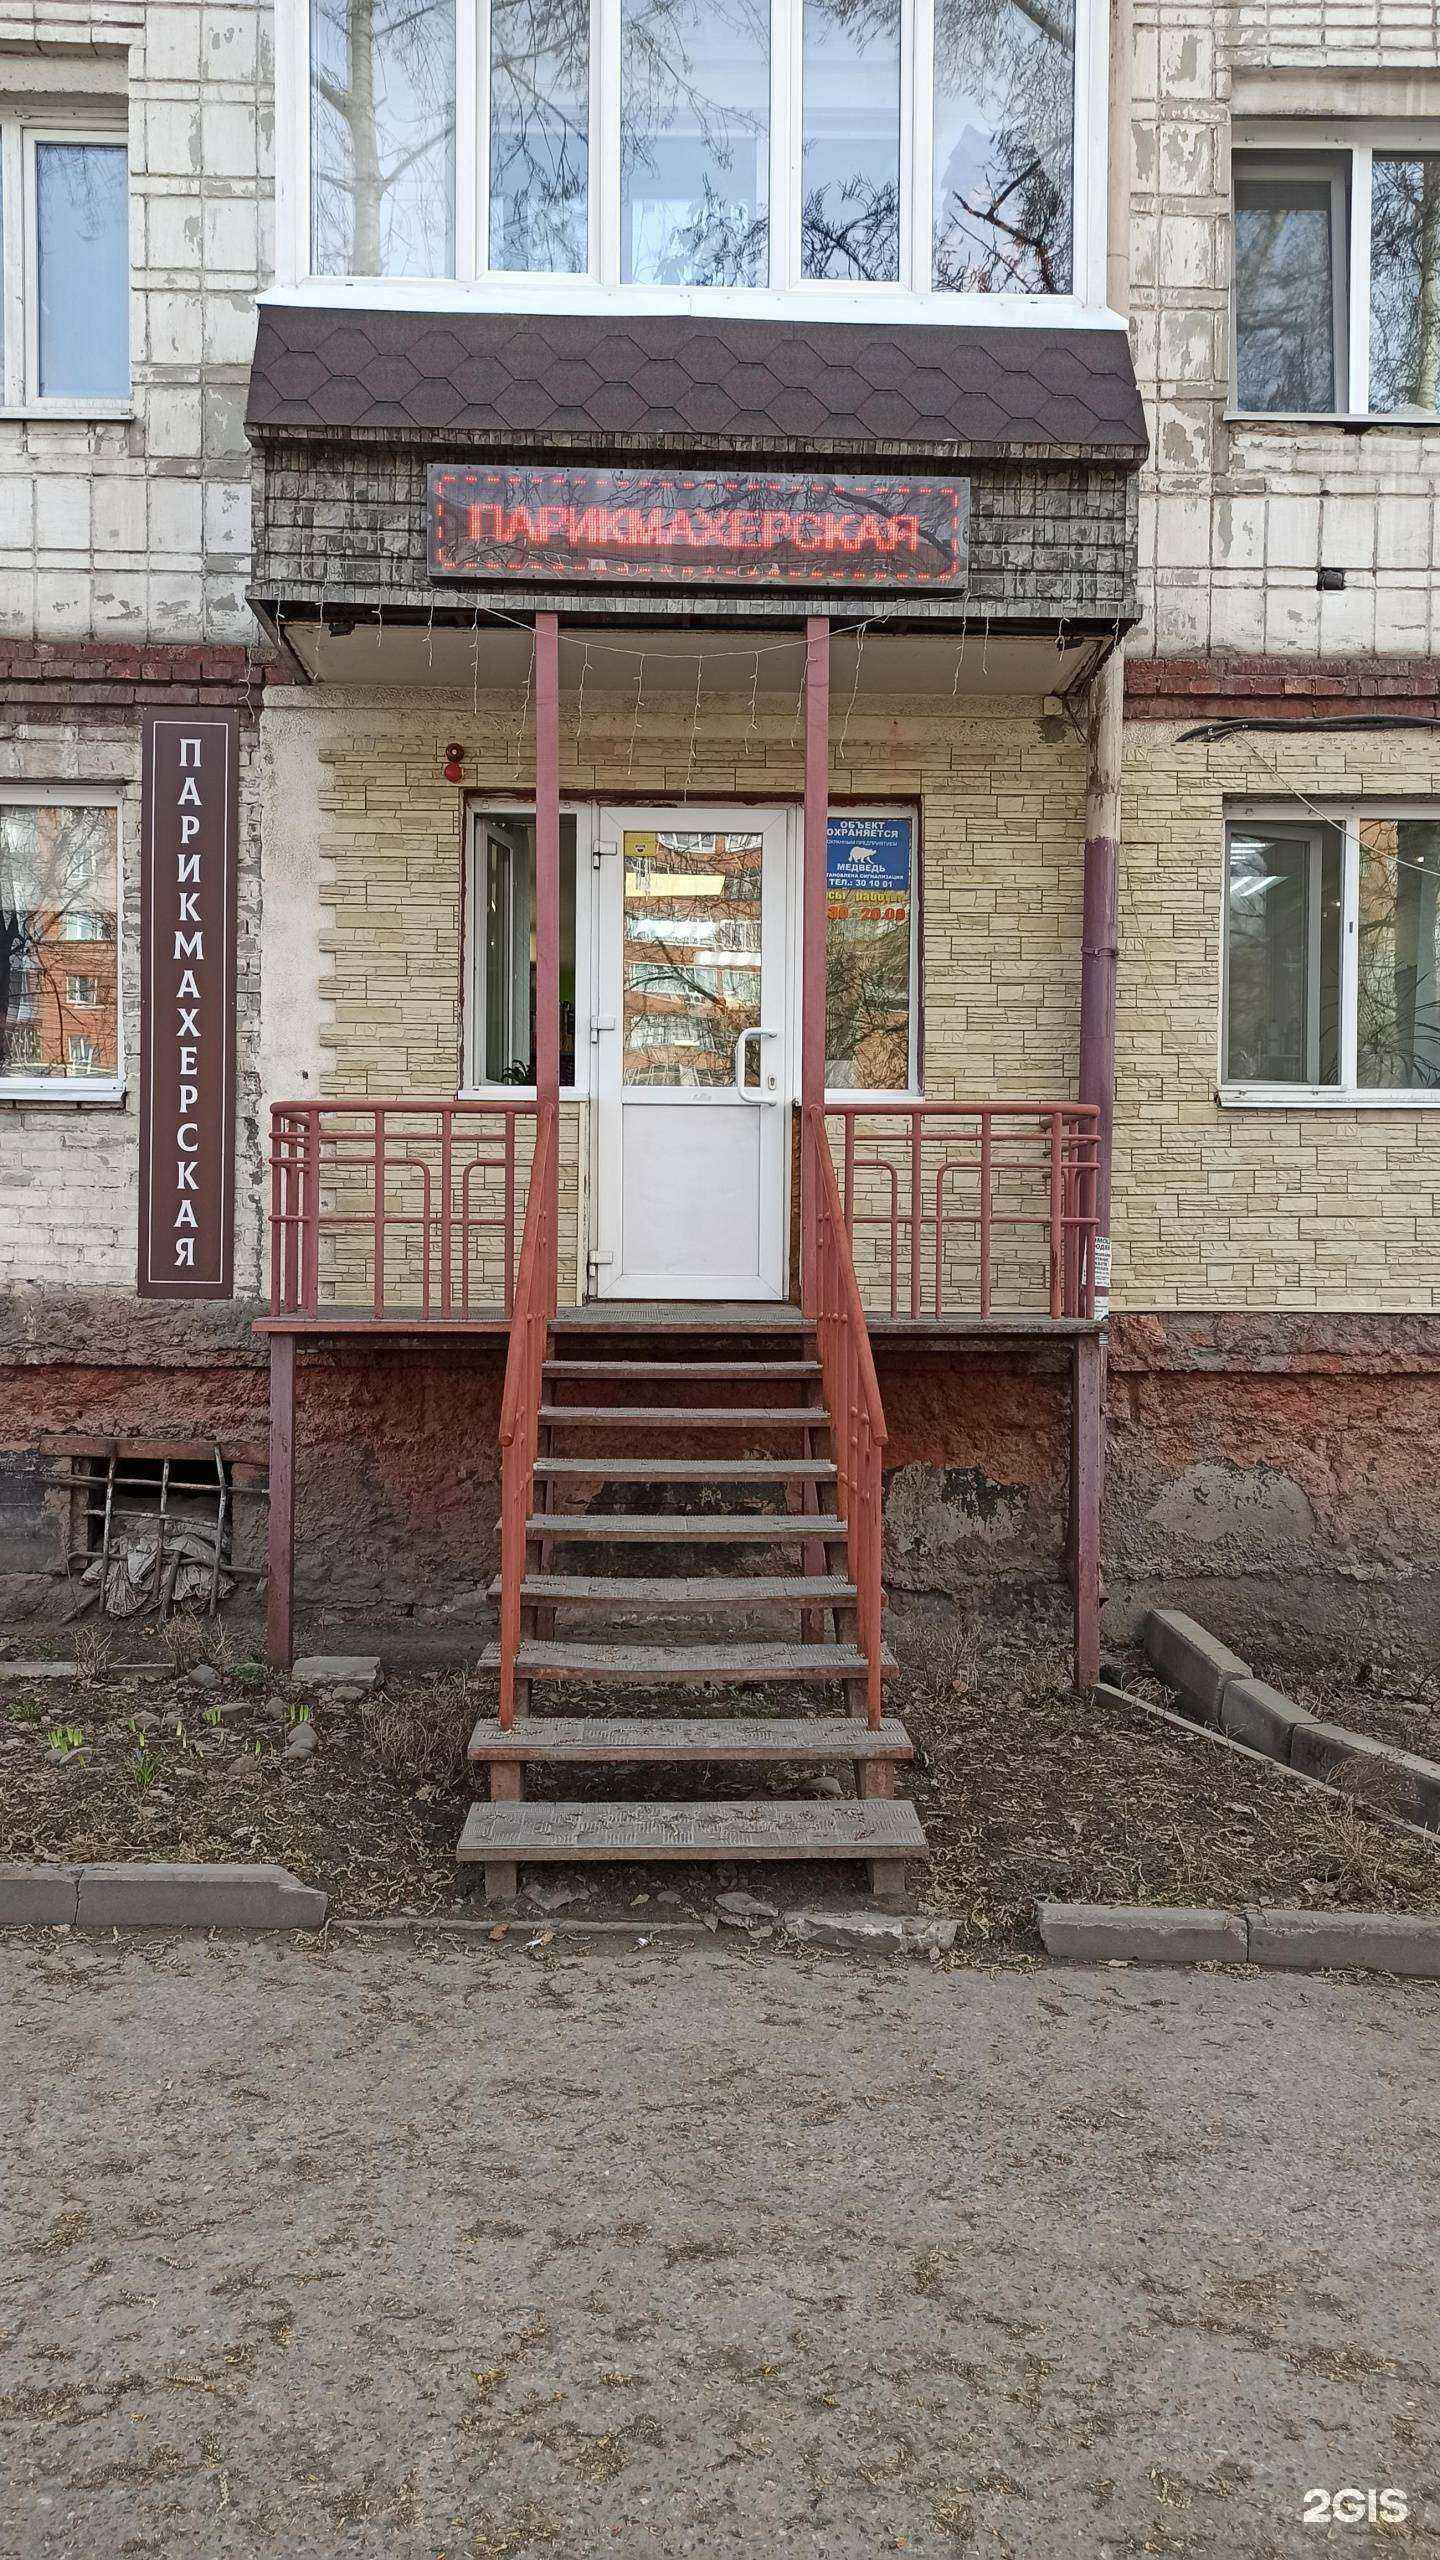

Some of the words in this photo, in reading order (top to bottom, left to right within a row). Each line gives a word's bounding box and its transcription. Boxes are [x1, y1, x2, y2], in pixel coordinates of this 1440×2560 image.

[467, 502, 920, 552] ПАРИКМАХЕРСКАЯ
[840, 820, 885, 829] ОБЪЕКТ
[826, 828, 898, 838] ОХРАНЯЕТСЯ
[836, 863, 886, 873] МЕДВЕДЬ
[855, 879, 866, 887] 30
[882, 880, 893, 888] 01
[174, 737, 205, 1267] ПАРИКМАХЕРСКАЯ
